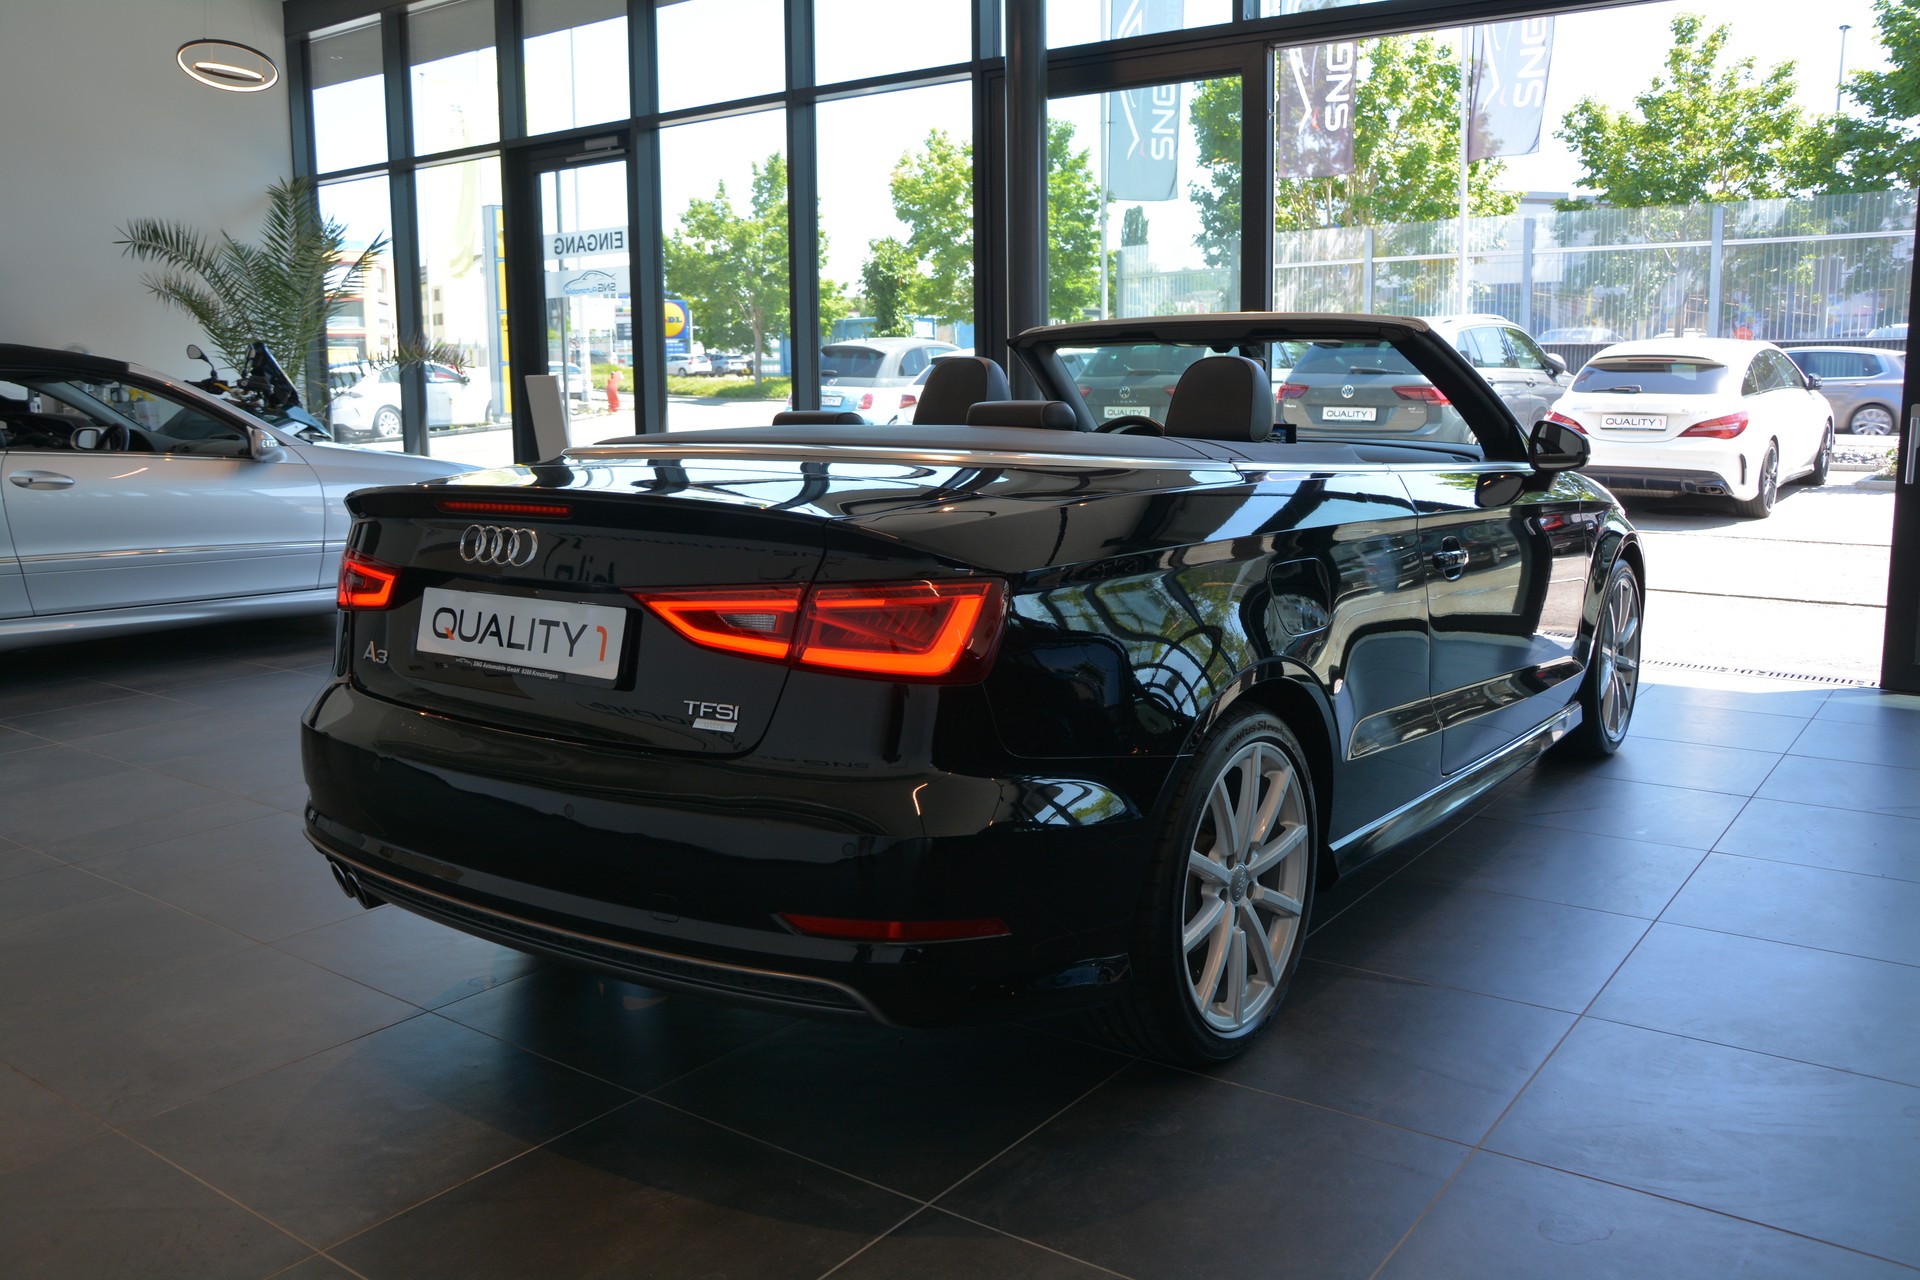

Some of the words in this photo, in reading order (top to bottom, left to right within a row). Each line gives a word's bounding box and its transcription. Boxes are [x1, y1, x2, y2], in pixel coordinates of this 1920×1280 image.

[1324, 42, 1354, 132] SNG
[1326, 410, 1368, 418] QUALITY
[1605, 418, 1656, 426] QUALITY
[1658, 418, 1663, 427] 1
[432, 607, 588, 657] QUALITY
[596, 625, 608, 662] 1
[362, 641, 388, 663] A3
[483, 662, 506, 671] Automobile
[683, 700, 740, 721] TFSI
